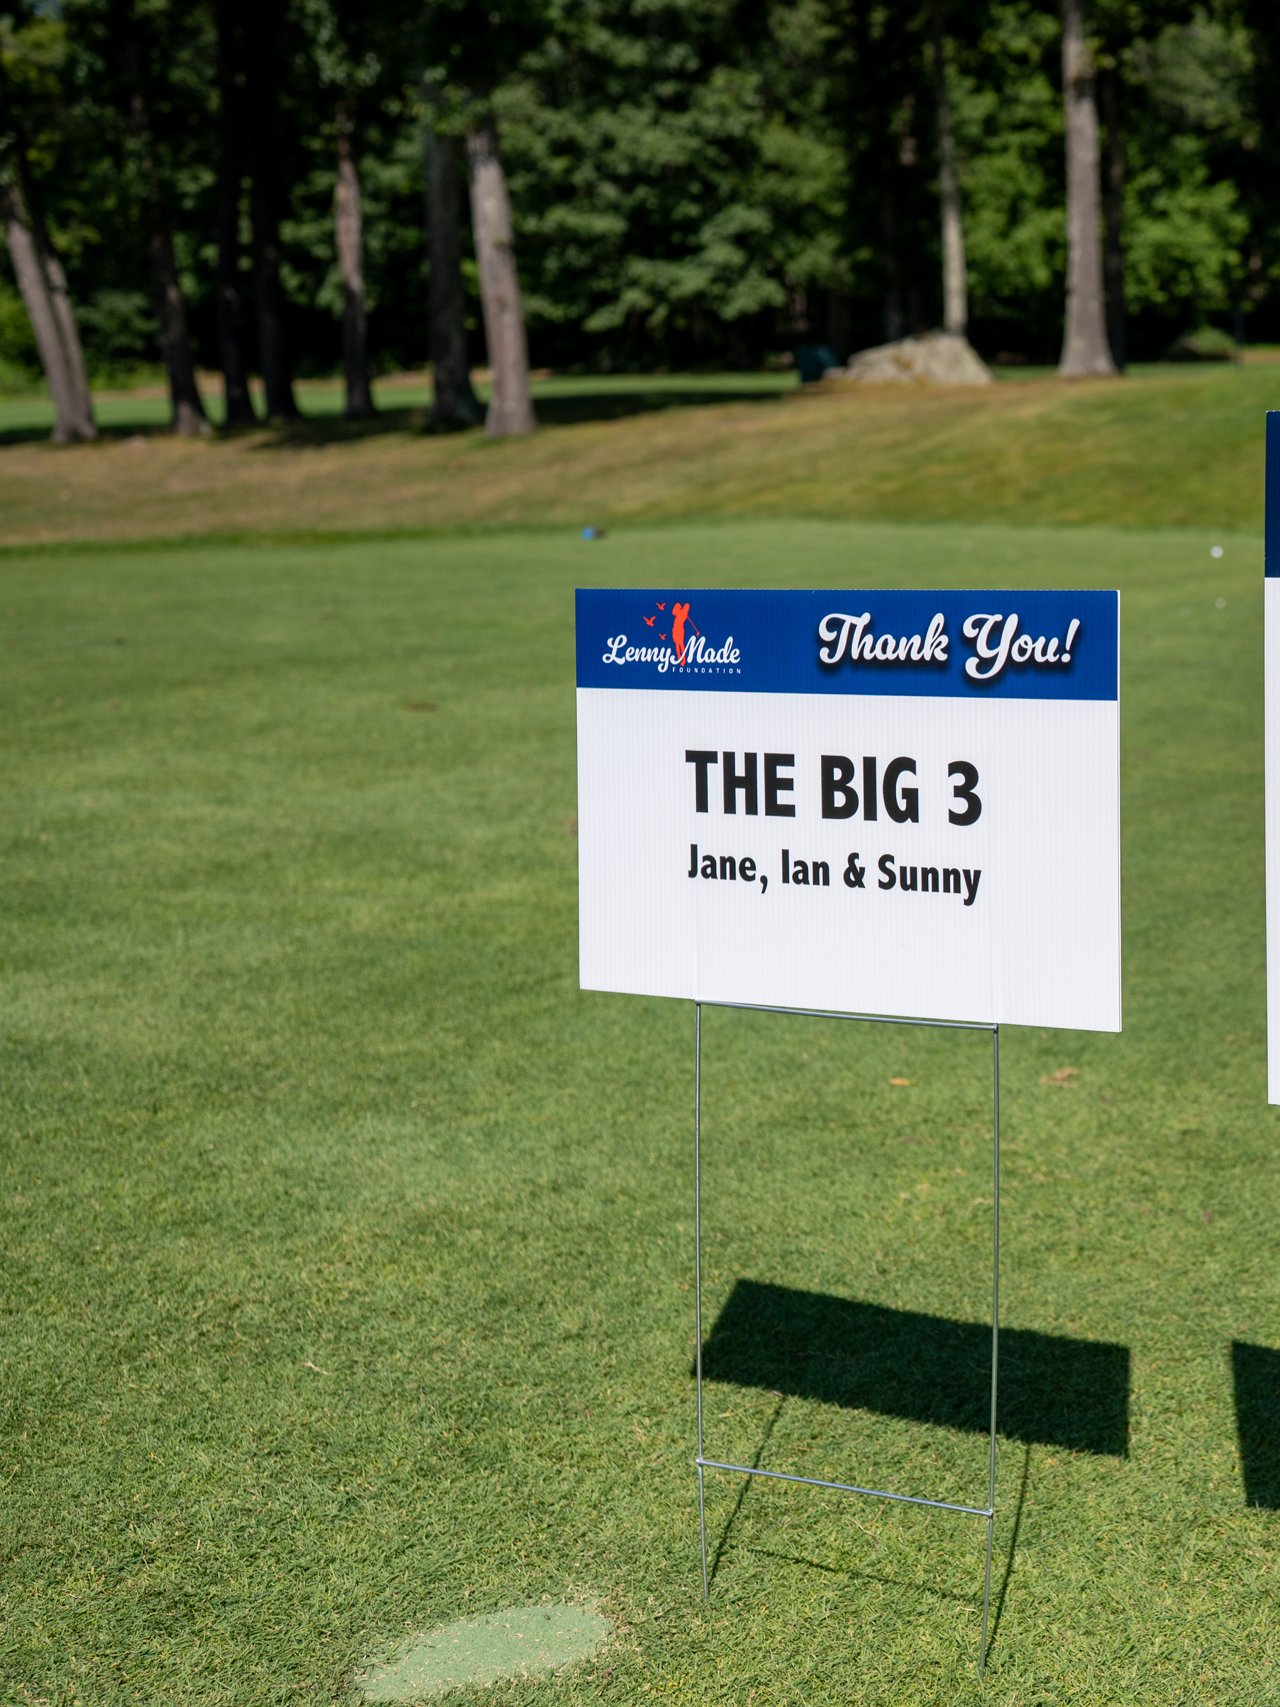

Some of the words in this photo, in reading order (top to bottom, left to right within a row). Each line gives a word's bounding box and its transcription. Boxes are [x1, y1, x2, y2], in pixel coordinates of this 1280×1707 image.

[602, 634, 671, 673] Lenny
[669, 635, 741, 665] Made
[672, 666, 742, 675] FOUNDATION
[817, 612, 950, 664] Thank
[962, 613, 1080, 680] You!
[685, 749, 797, 818] THE
[820, 754, 920, 824] BIG
[946, 760, 983, 827] 3
[688, 843, 769, 894] Jane,
[781, 848, 831, 888] Ian
[842, 852, 866, 889] &
[877, 853, 983, 907] Sunny
